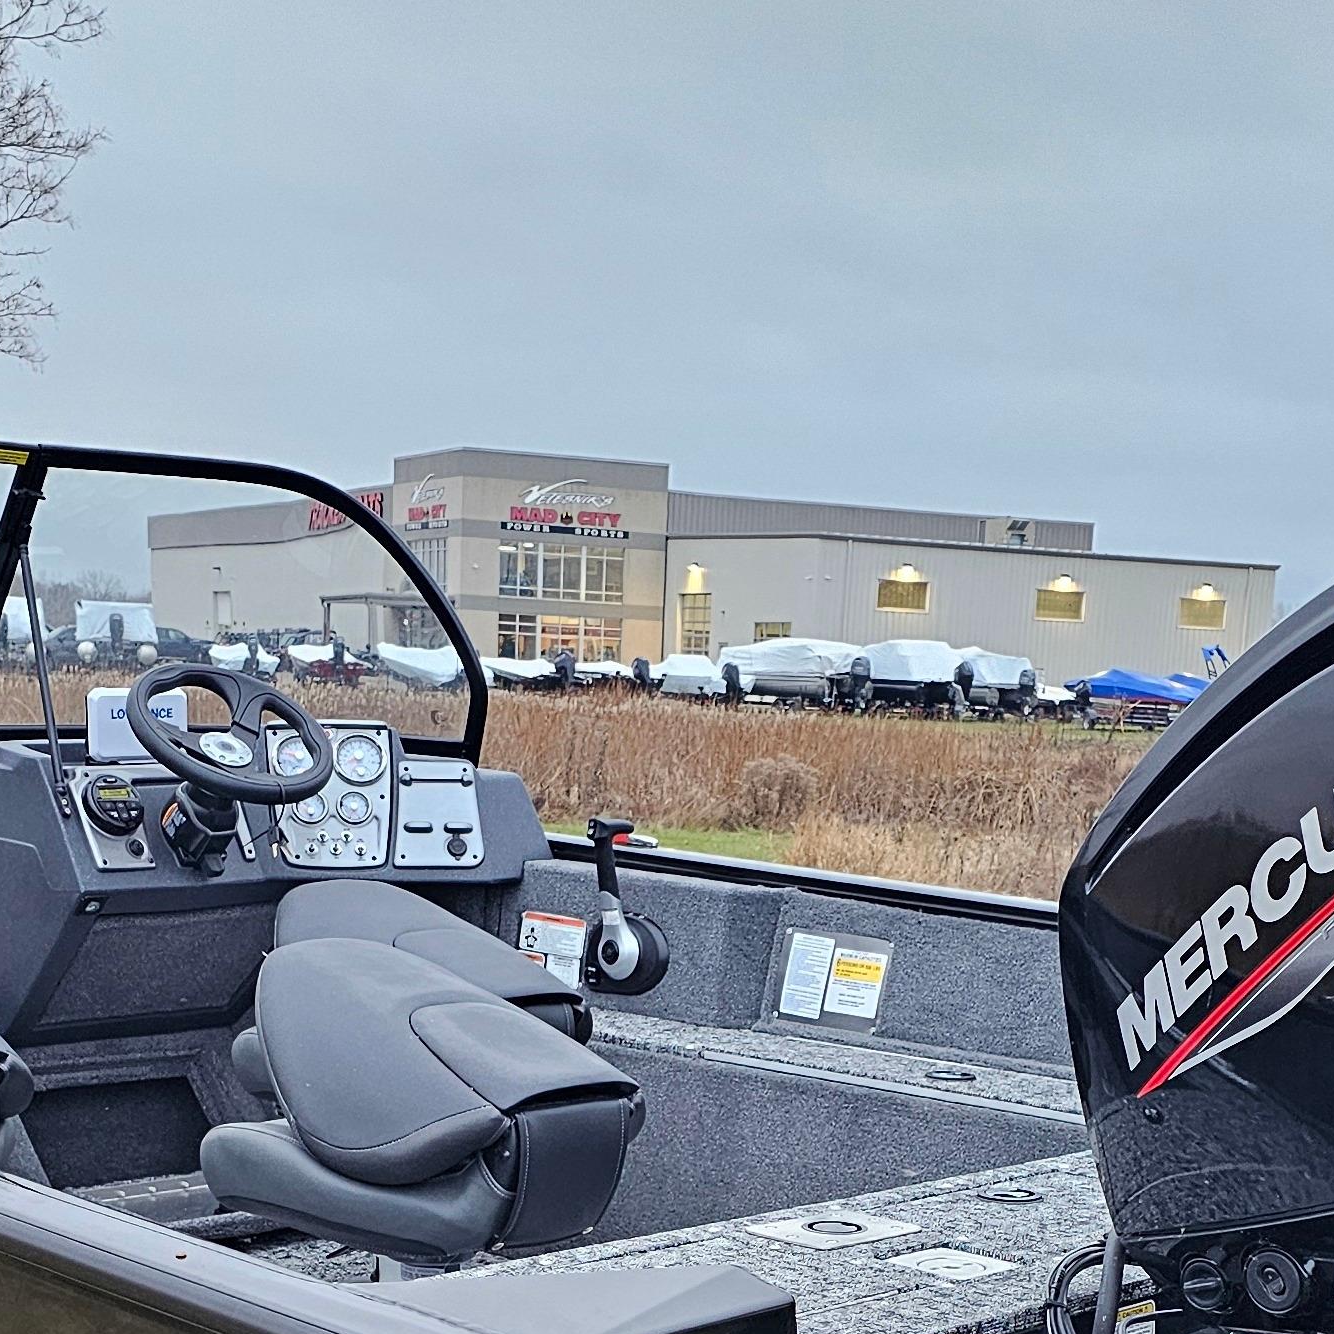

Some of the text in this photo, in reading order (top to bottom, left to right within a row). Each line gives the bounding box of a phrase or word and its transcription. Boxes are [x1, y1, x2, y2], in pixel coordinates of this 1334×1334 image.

[510, 506, 622, 527] MAD CITY
[506, 522, 624, 538] POWER SPORTS
[111, 708, 173, 720] LONCE
